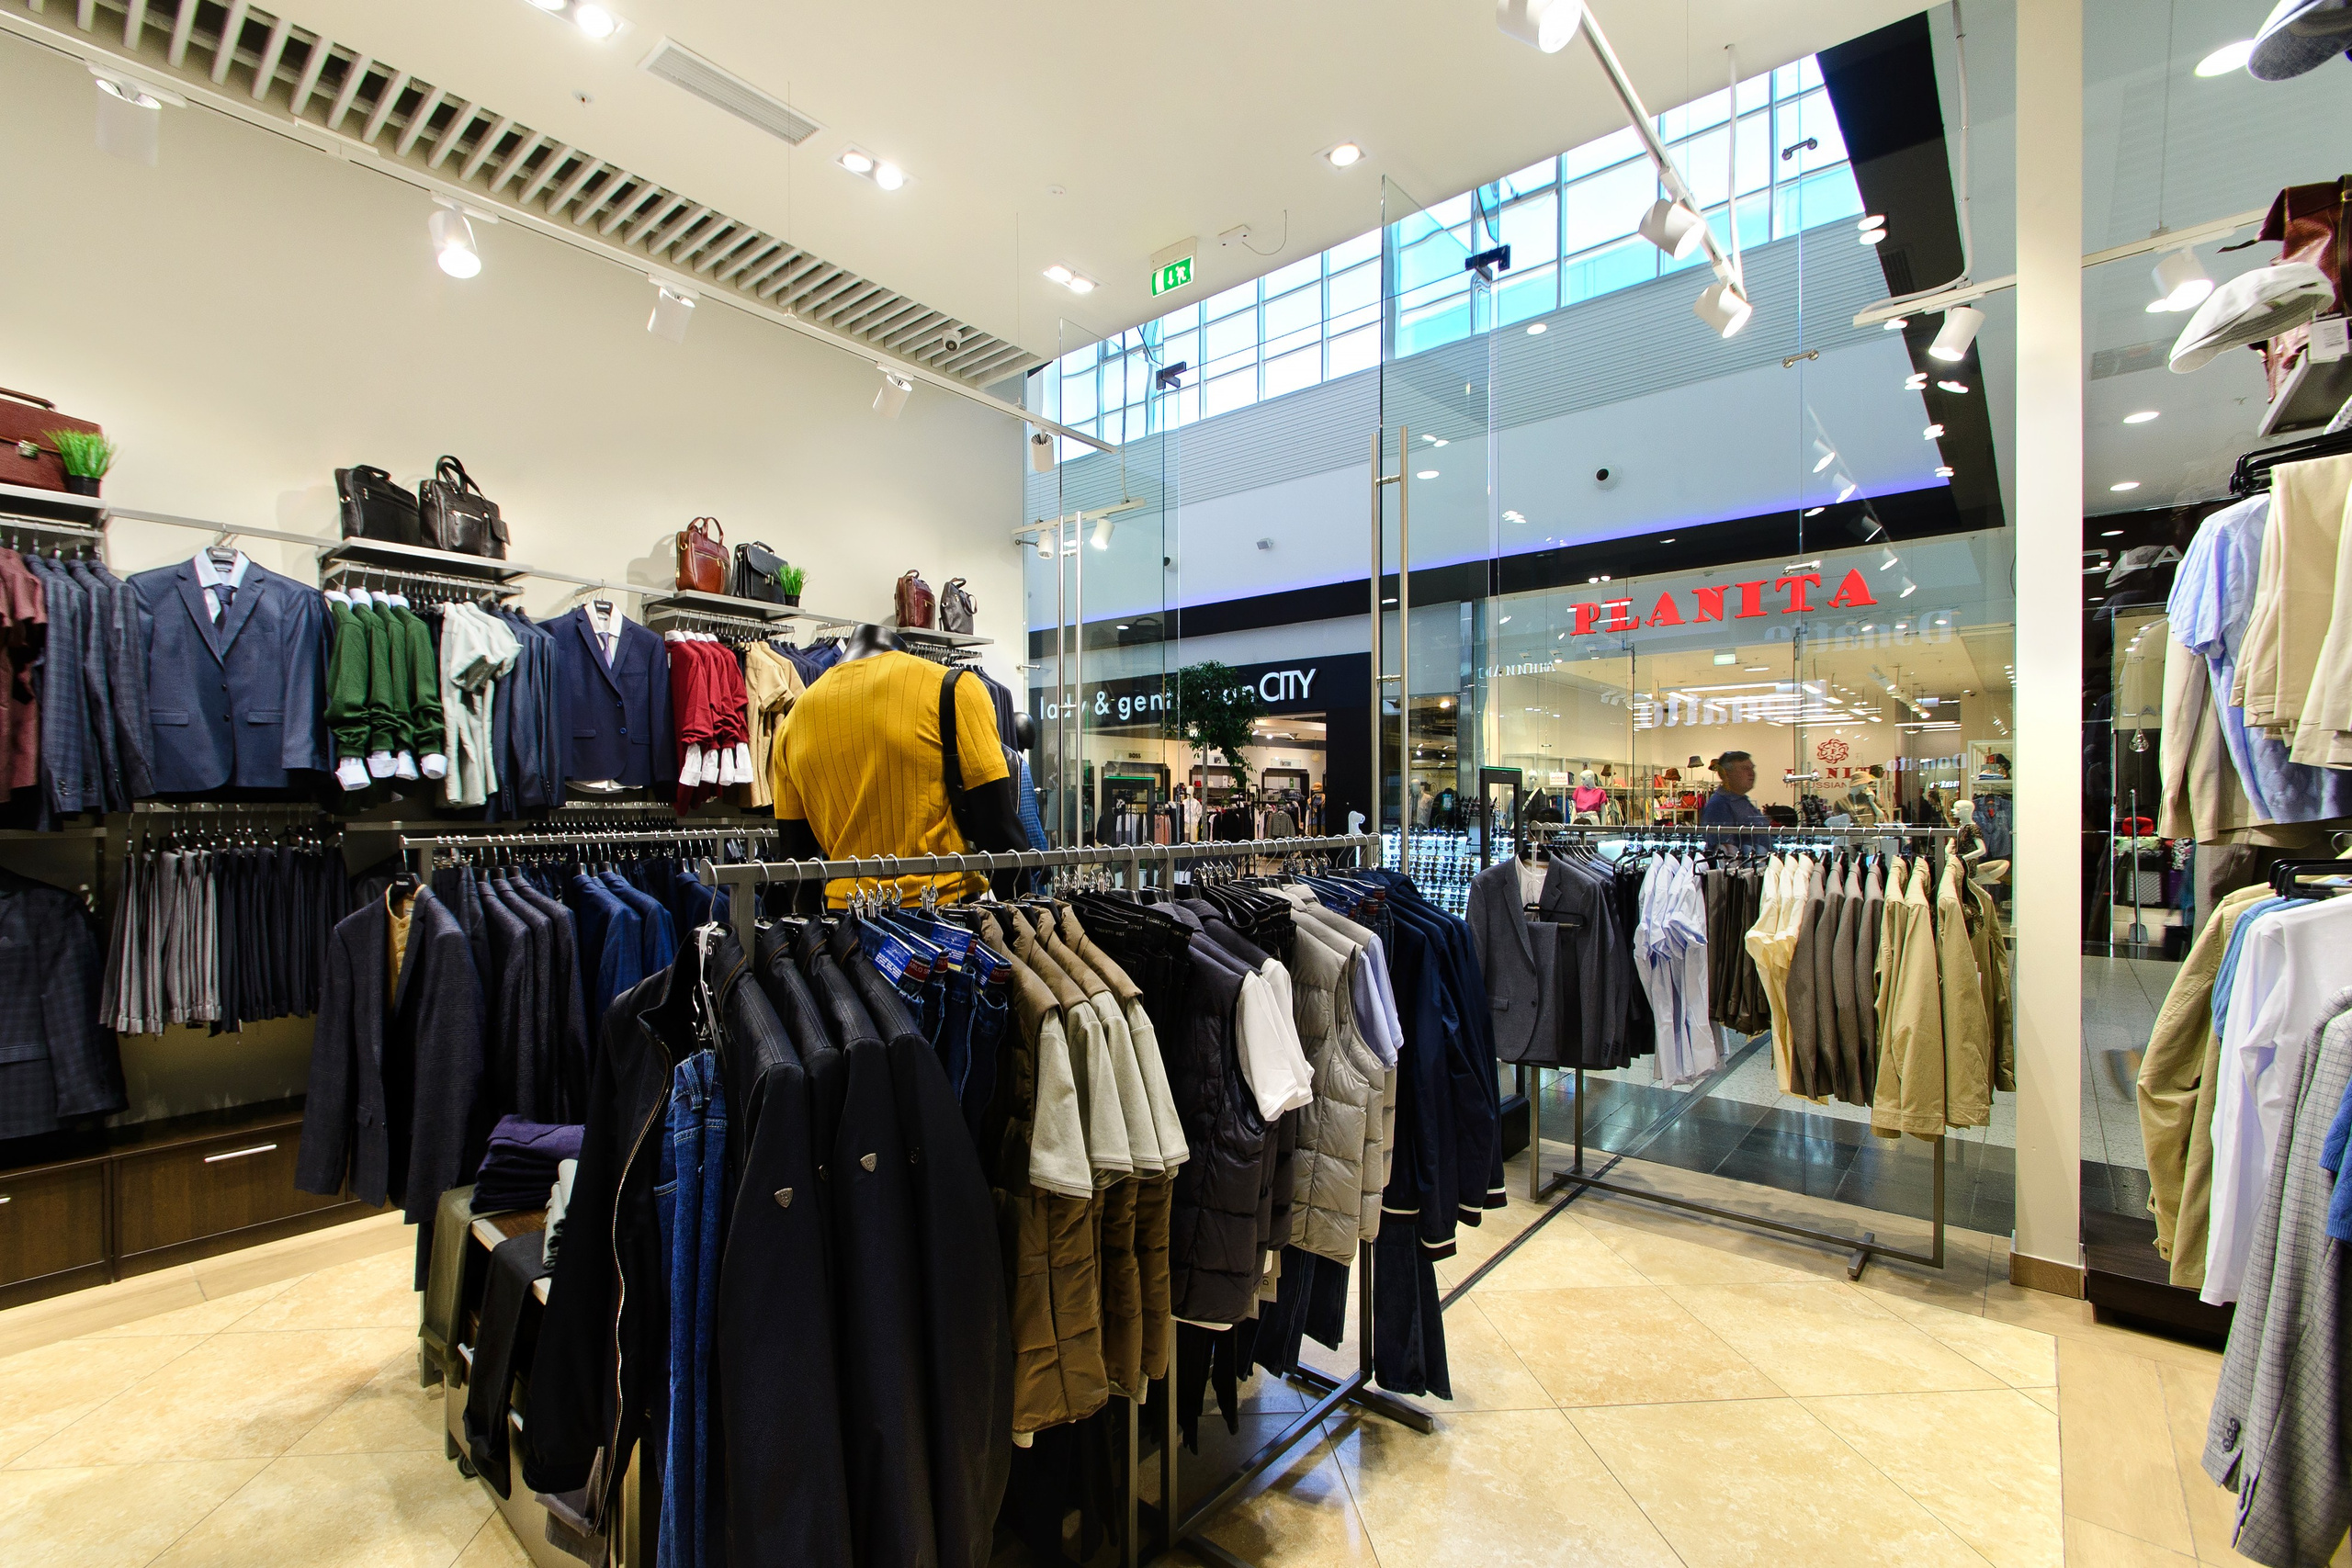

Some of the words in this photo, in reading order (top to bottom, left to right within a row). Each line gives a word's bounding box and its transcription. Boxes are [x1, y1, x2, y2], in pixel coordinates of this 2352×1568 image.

[1569, 569, 1878, 636] PLANITA
[1094, 691, 1111, 716] &
[1259, 668, 1317, 703] CITY
